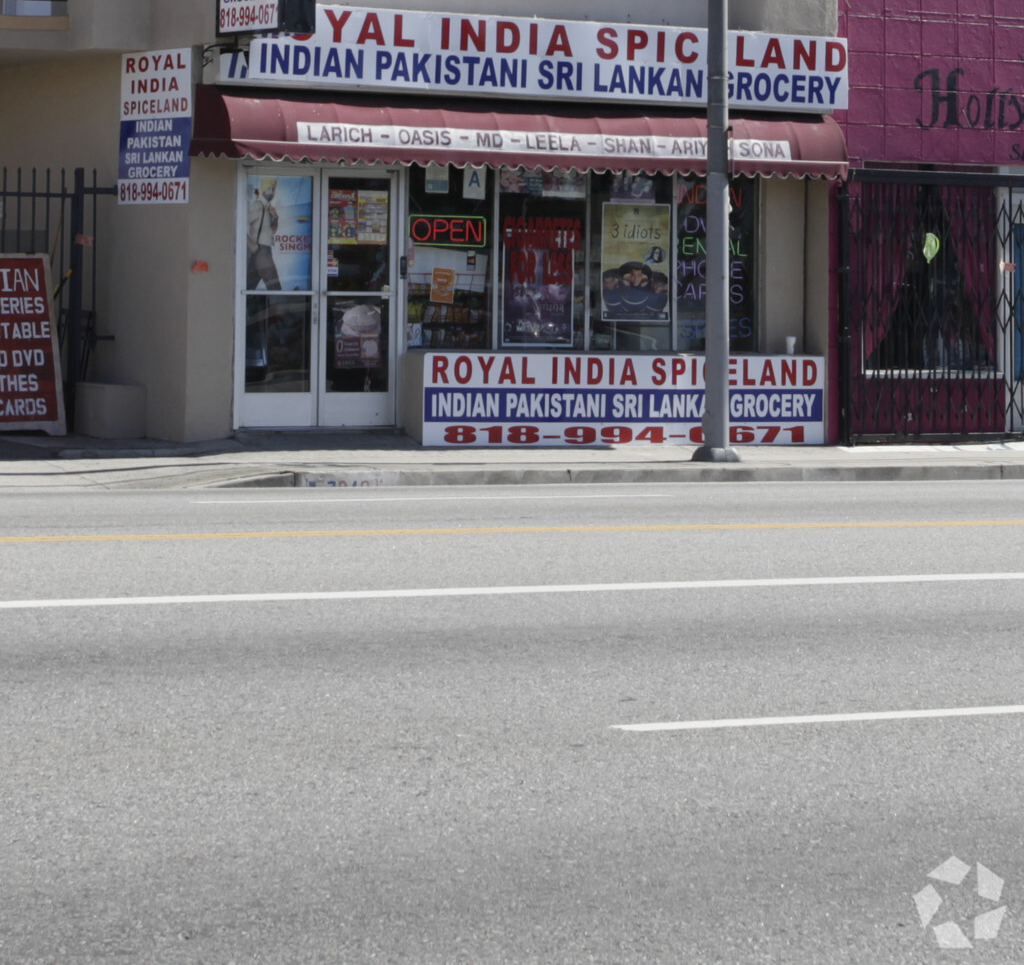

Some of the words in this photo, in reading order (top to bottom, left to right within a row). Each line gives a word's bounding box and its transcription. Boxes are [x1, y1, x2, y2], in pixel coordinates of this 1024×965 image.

[441, 17, 573, 58] INDIA
[596, 27, 847, 72] SPICLAND
[126, 53, 186, 73] ROYAL
[260, 43, 364, 79] INDIAN
[375, 51, 527, 89] PAKISTANI
[537, 60, 583, 91] SRI
[594, 63, 704, 98] LANKAN
[131, 77, 179, 94] INDIA
[123, 97, 188, 116] SPICELAND
[135, 119, 172, 133] INDIAN
[127, 135, 181, 149] PAKISTAN
[307, 125, 373, 143] LARICH
[398, 129, 451, 146] OASIS
[477, 133, 503, 148] MD
[526, 135, 581, 151] LEELA
[604, 138, 652, 154] SHAN
[739, 142, 785, 158] SONA
[125, 152, 140, 164] SRI
[143, 151, 183, 163] LANKAN
[128, 165, 178, 179] GROCERY
[468, 170, 481, 188] A
[120, 181, 186, 202] 818-994-0671
[411, 218, 483, 242] OPEN
[611, 224, 619, 239] 3
[623, 224, 662, 240] idiots
[510, 251, 536, 284] FOR
[543, 251, 573, 285] LESS
[12, 349, 45, 368] DVD
[432, 355, 535, 384] ROYAL
[552, 357, 637, 385] INDIA
[651, 358, 817, 386] SPIELAND
[432, 392, 499, 417] INDIAN
[506, 393, 606, 417] PAKISTANI
[612, 393, 643, 418] SRI
[730, 393, 816, 418] GROCERY
